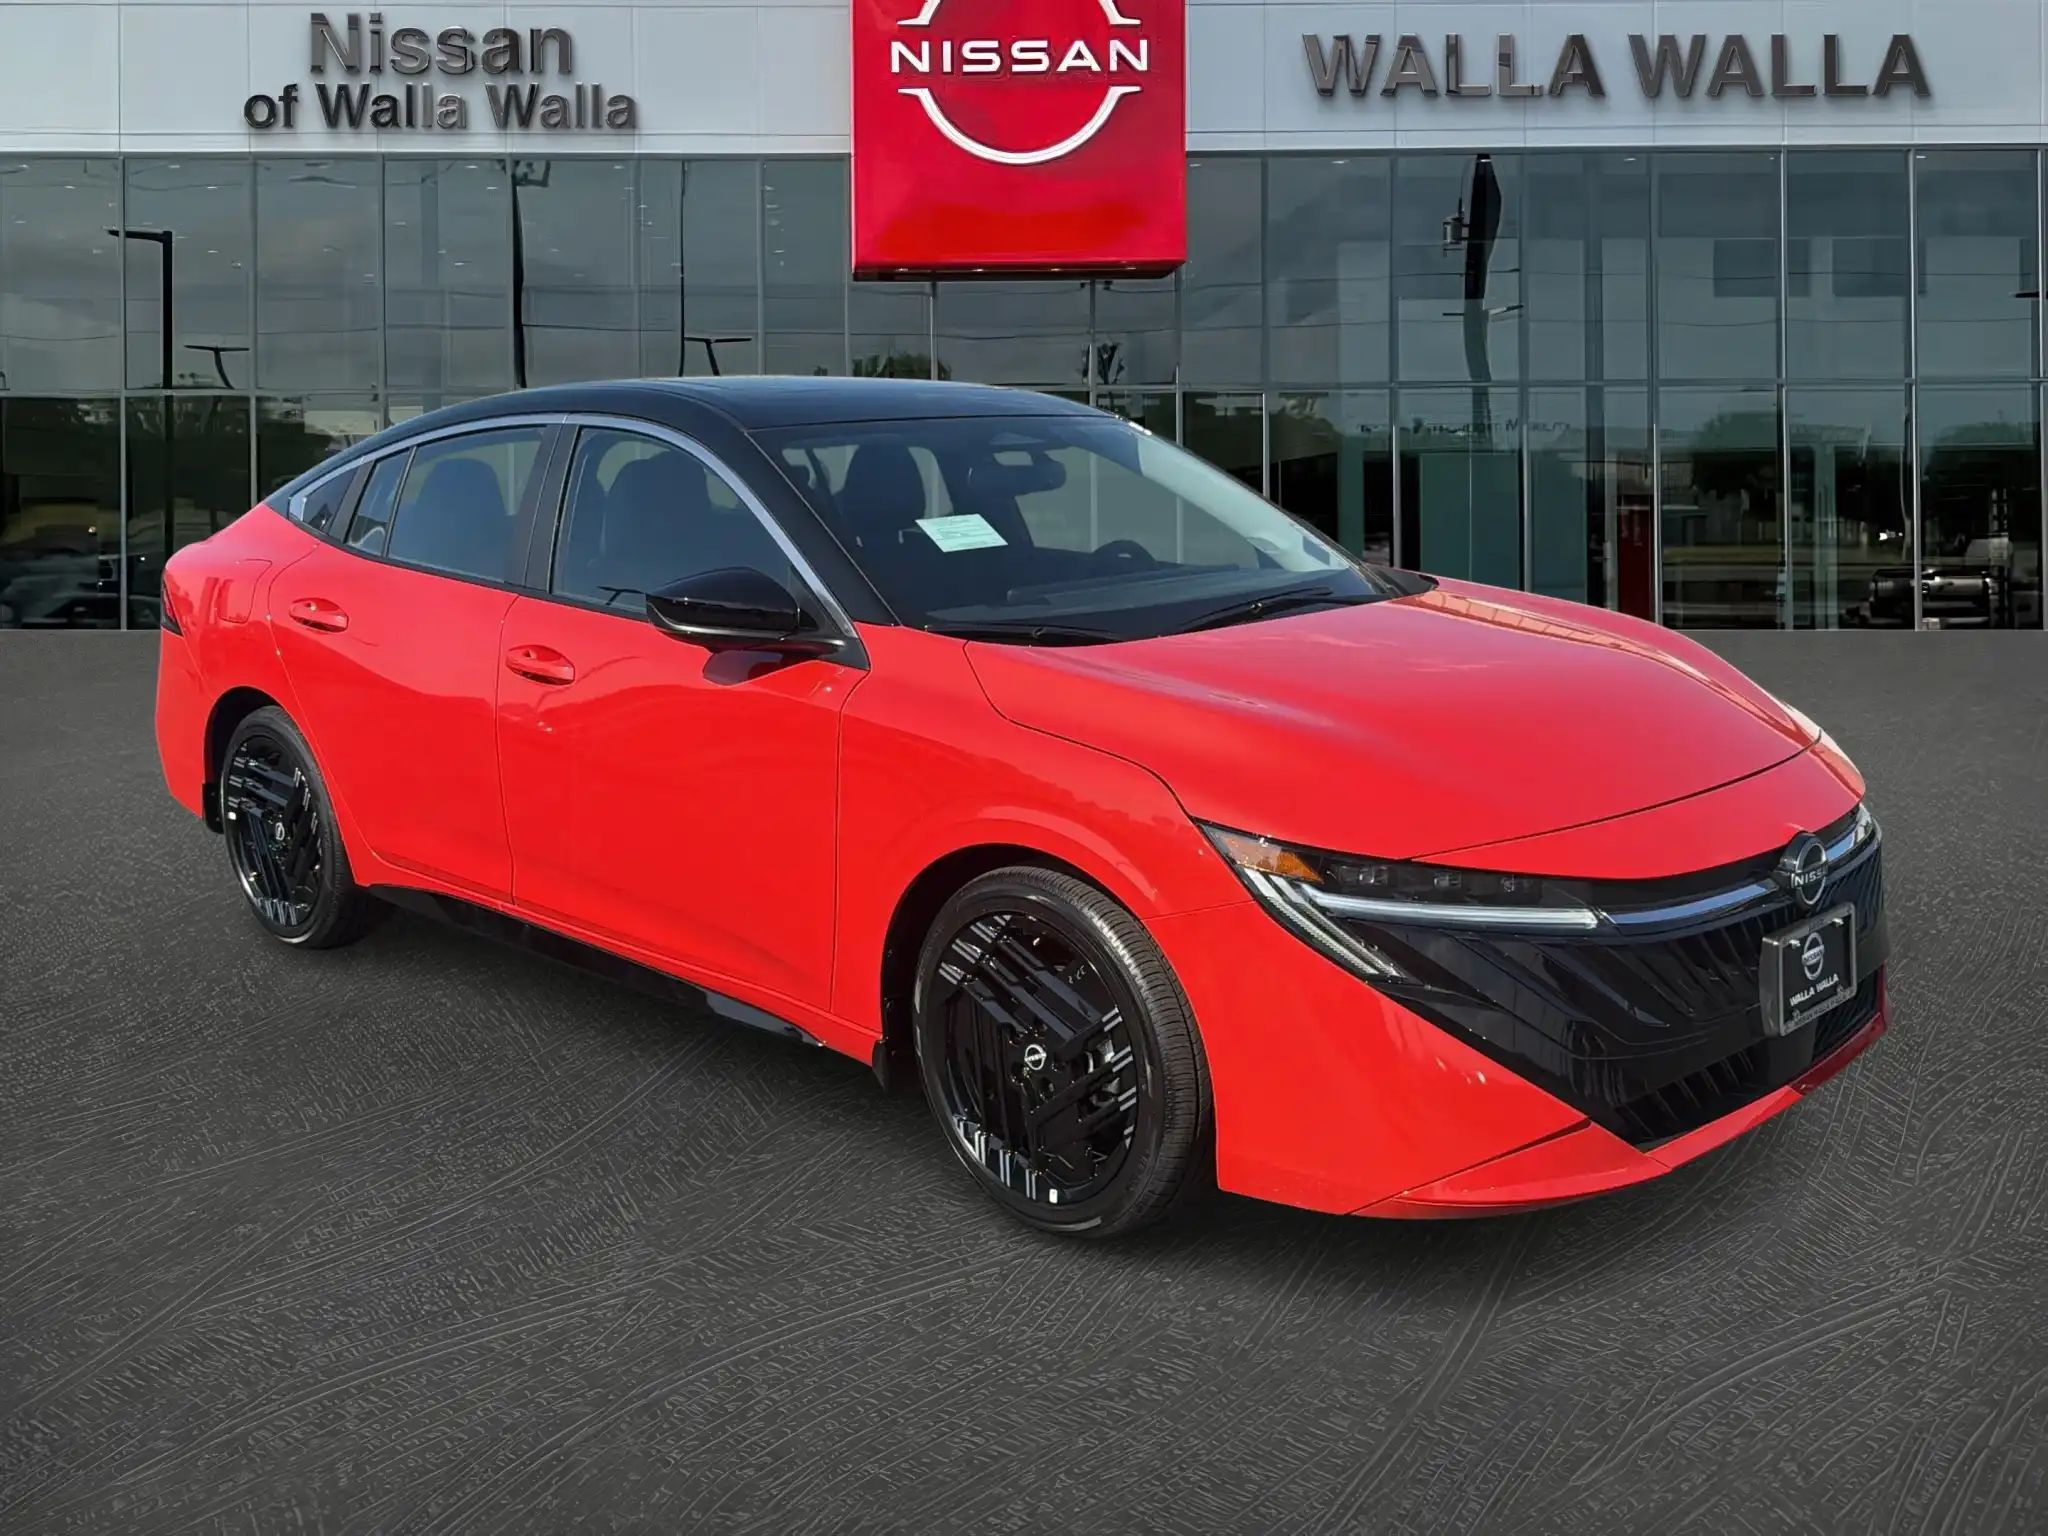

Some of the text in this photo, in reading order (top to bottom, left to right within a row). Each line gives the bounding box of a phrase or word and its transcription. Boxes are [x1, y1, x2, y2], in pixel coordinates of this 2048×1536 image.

[310, 12, 573, 75] Nissan
[890, 39, 1149, 73] NISSAN
[1302, 33, 1931, 98] WALLA WALLA
[243, 82, 638, 129] of Walla Walla
[1794, 867, 1822, 887] NISS
[1789, 973, 1839, 1006] WALLA WALLA
